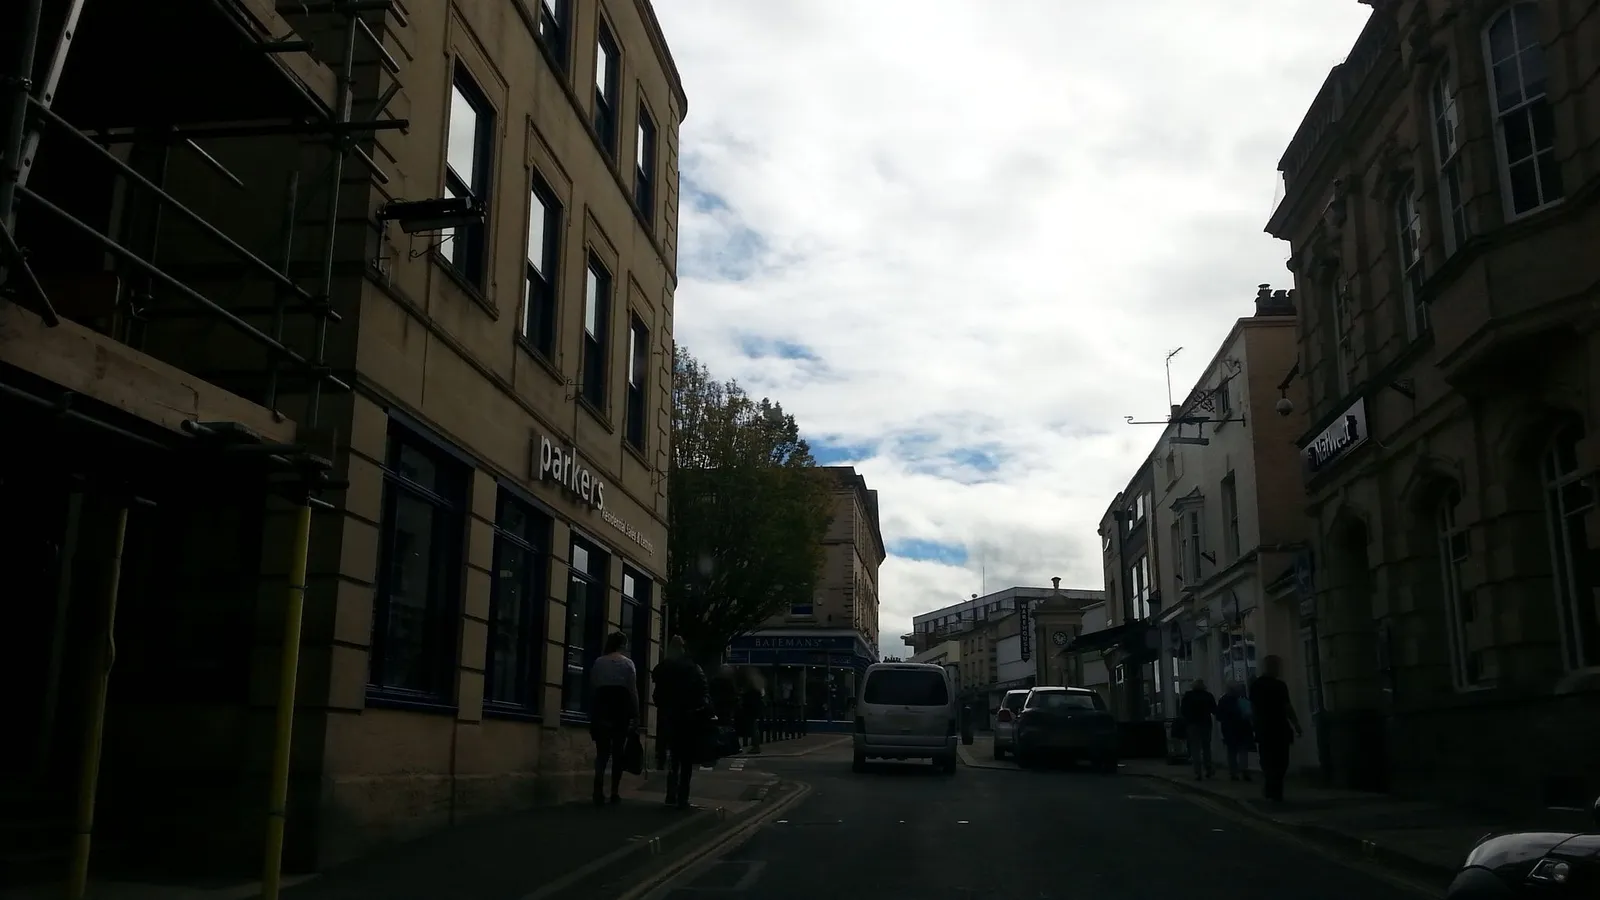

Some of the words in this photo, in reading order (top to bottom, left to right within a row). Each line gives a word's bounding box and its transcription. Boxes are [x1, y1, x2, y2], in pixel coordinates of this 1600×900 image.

[1314, 415, 1351, 466] NatWest
[540, 436, 604, 510] parkers
[755, 638, 819, 648] BATEMANS
